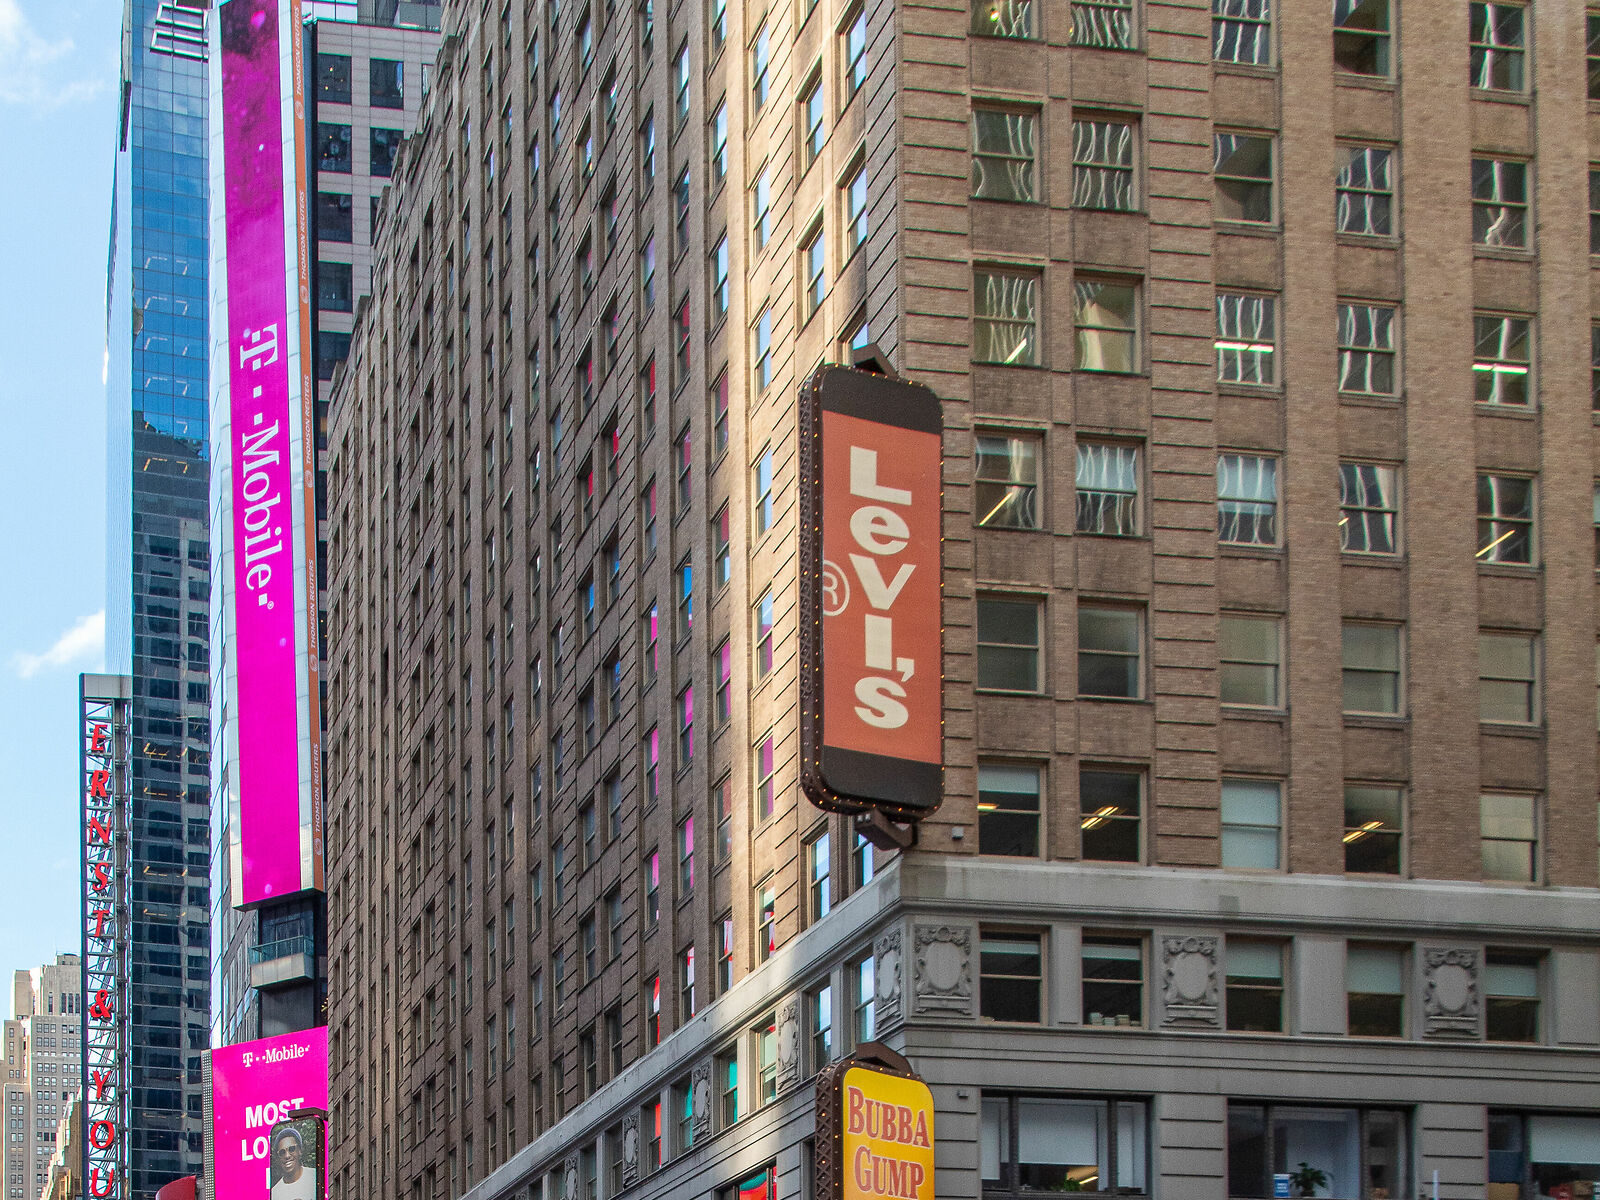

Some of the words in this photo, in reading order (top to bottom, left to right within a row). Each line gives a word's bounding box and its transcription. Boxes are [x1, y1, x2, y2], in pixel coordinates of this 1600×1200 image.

[293, 6, 301, 48] REUTERS
[298, 190, 306, 235] REUTERS
[300, 236, 308, 281] THOMSON
[309, 602, 317, 649] THOMSON
[89, 724, 110, 938] ERNST
[89, 989, 113, 1019] &
[847, 1085, 931, 1149] BUBBA
[854, 1145, 925, 1200] GUMP
